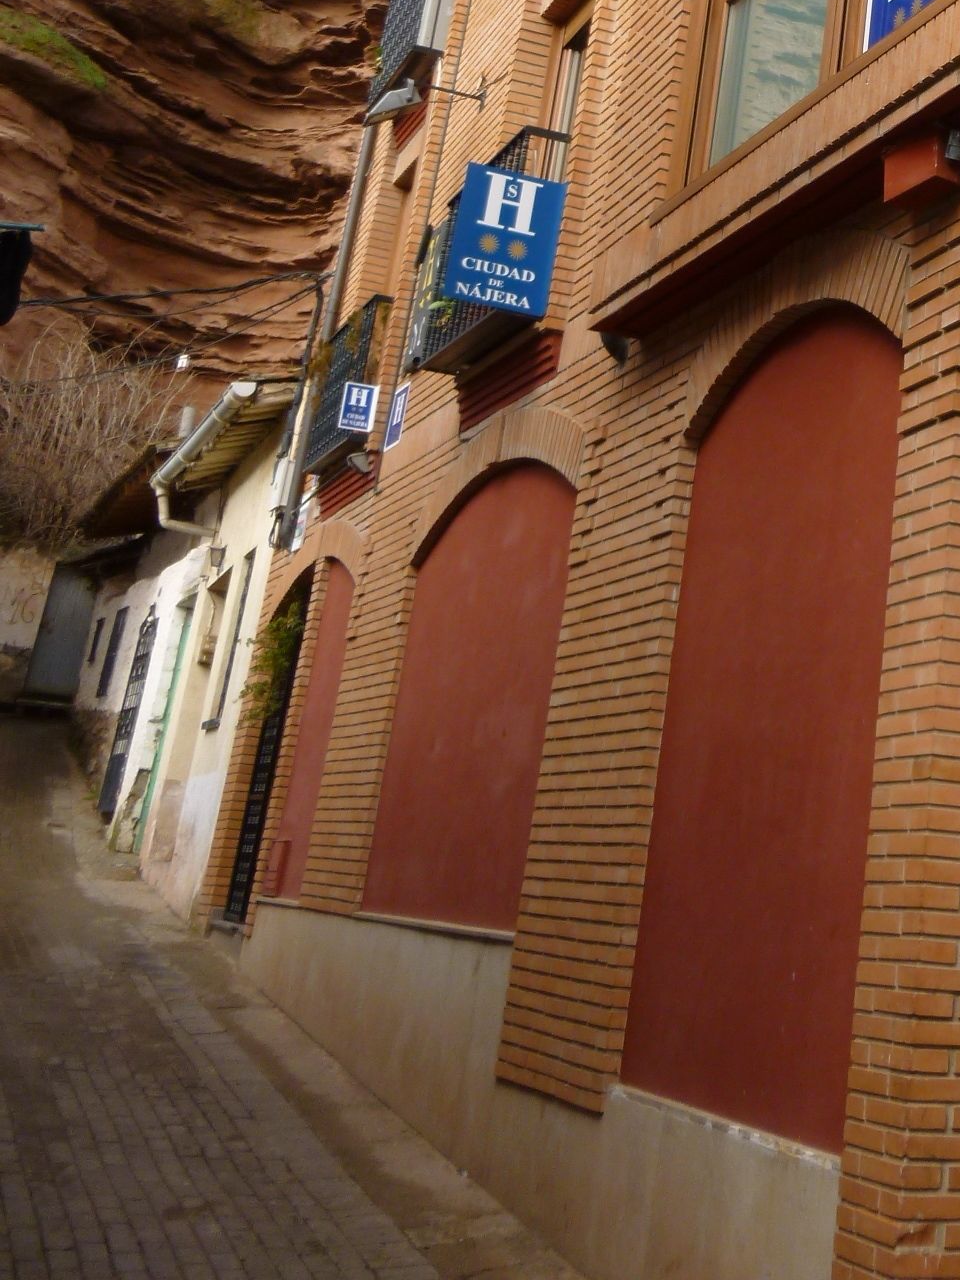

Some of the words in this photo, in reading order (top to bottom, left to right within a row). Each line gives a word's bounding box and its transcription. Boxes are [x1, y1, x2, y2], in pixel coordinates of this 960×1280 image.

[460, 256, 537, 283] CIUDAD
[487, 277, 505, 289] DE
[455, 280, 531, 310] NÁJERA
